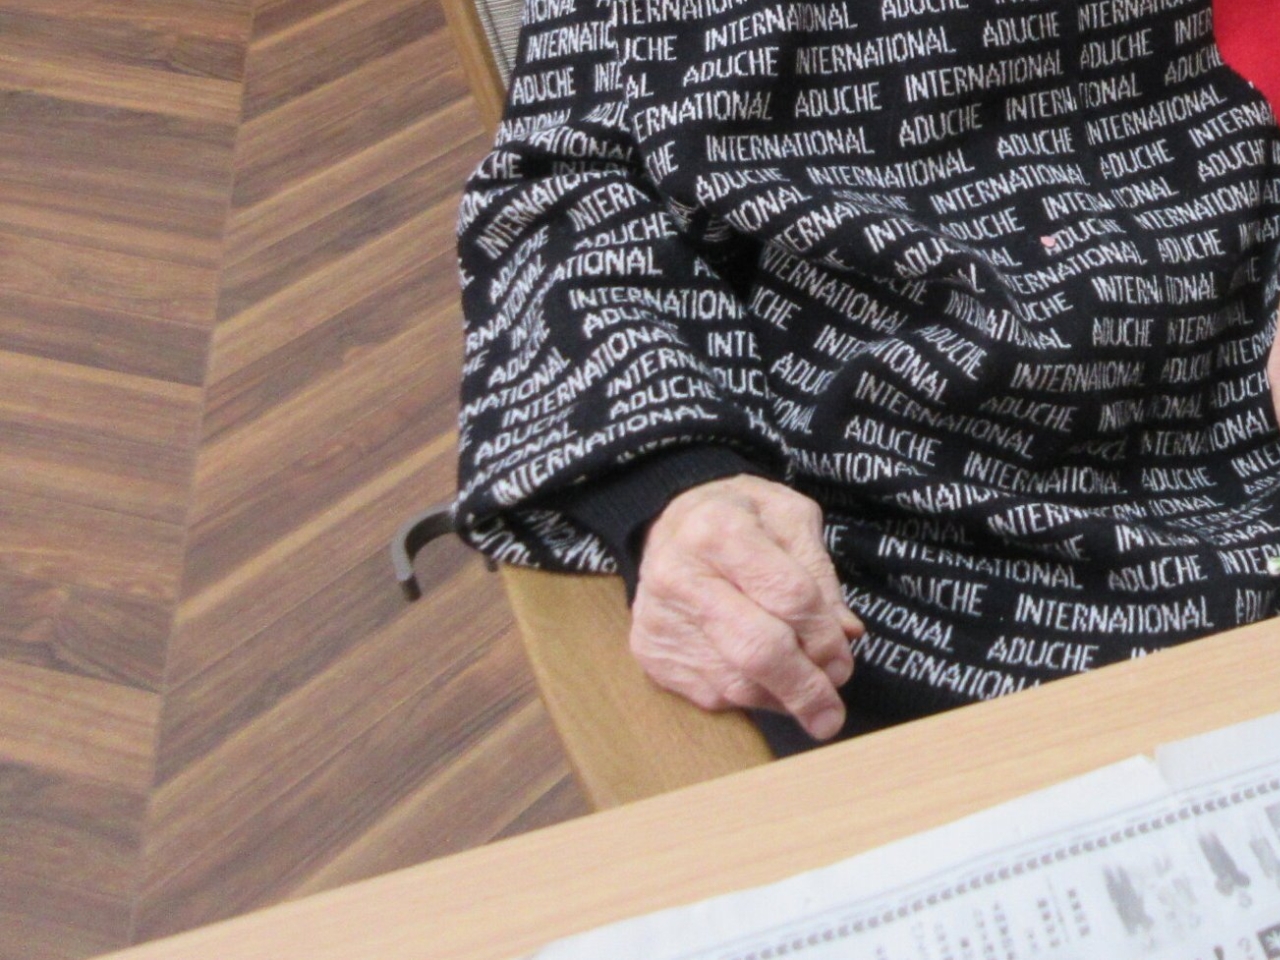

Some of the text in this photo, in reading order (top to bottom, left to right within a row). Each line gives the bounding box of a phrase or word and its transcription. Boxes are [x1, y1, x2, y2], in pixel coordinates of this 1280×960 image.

[683, 46, 781, 88] ADUCHE
[796, 26, 957, 76] INTERNATIONAL
[981, 10, 1060, 49] ADUCHE
[795, 82, 883, 120] ADUCHE
[904, 48, 1065, 103] INTERNATIONAL
[1080, 27, 1155, 71] ADUCHE
[512, 67, 578, 106] ADUCHE
[706, 126, 876, 162] INTERNATIONAL
[899, 103, 983, 148] ADUCHE
[997, 84, 1229, 160] ADUCHE INTERNATIONAL
[695, 167, 792, 208] ADUCHE
[806, 148, 977, 189] INTERNATIONAL
[929, 138, 1176, 215] INTERNATIONAL ADUCHE
[854, 370, 1035, 460] INTERNATIONAL
[843, 415, 942, 467] ADUCHE
[963, 450, 1128, 496] INTERNATIONAL
[1141, 465, 1218, 492] ADUCHE
[878, 534, 1083, 589] INTERNATIONAL
[1107, 555, 1208, 593] ADUCHE
[1014, 593, 1215, 633] INTERNATIONAL
[986, 634, 1099, 673] ADUCHE
